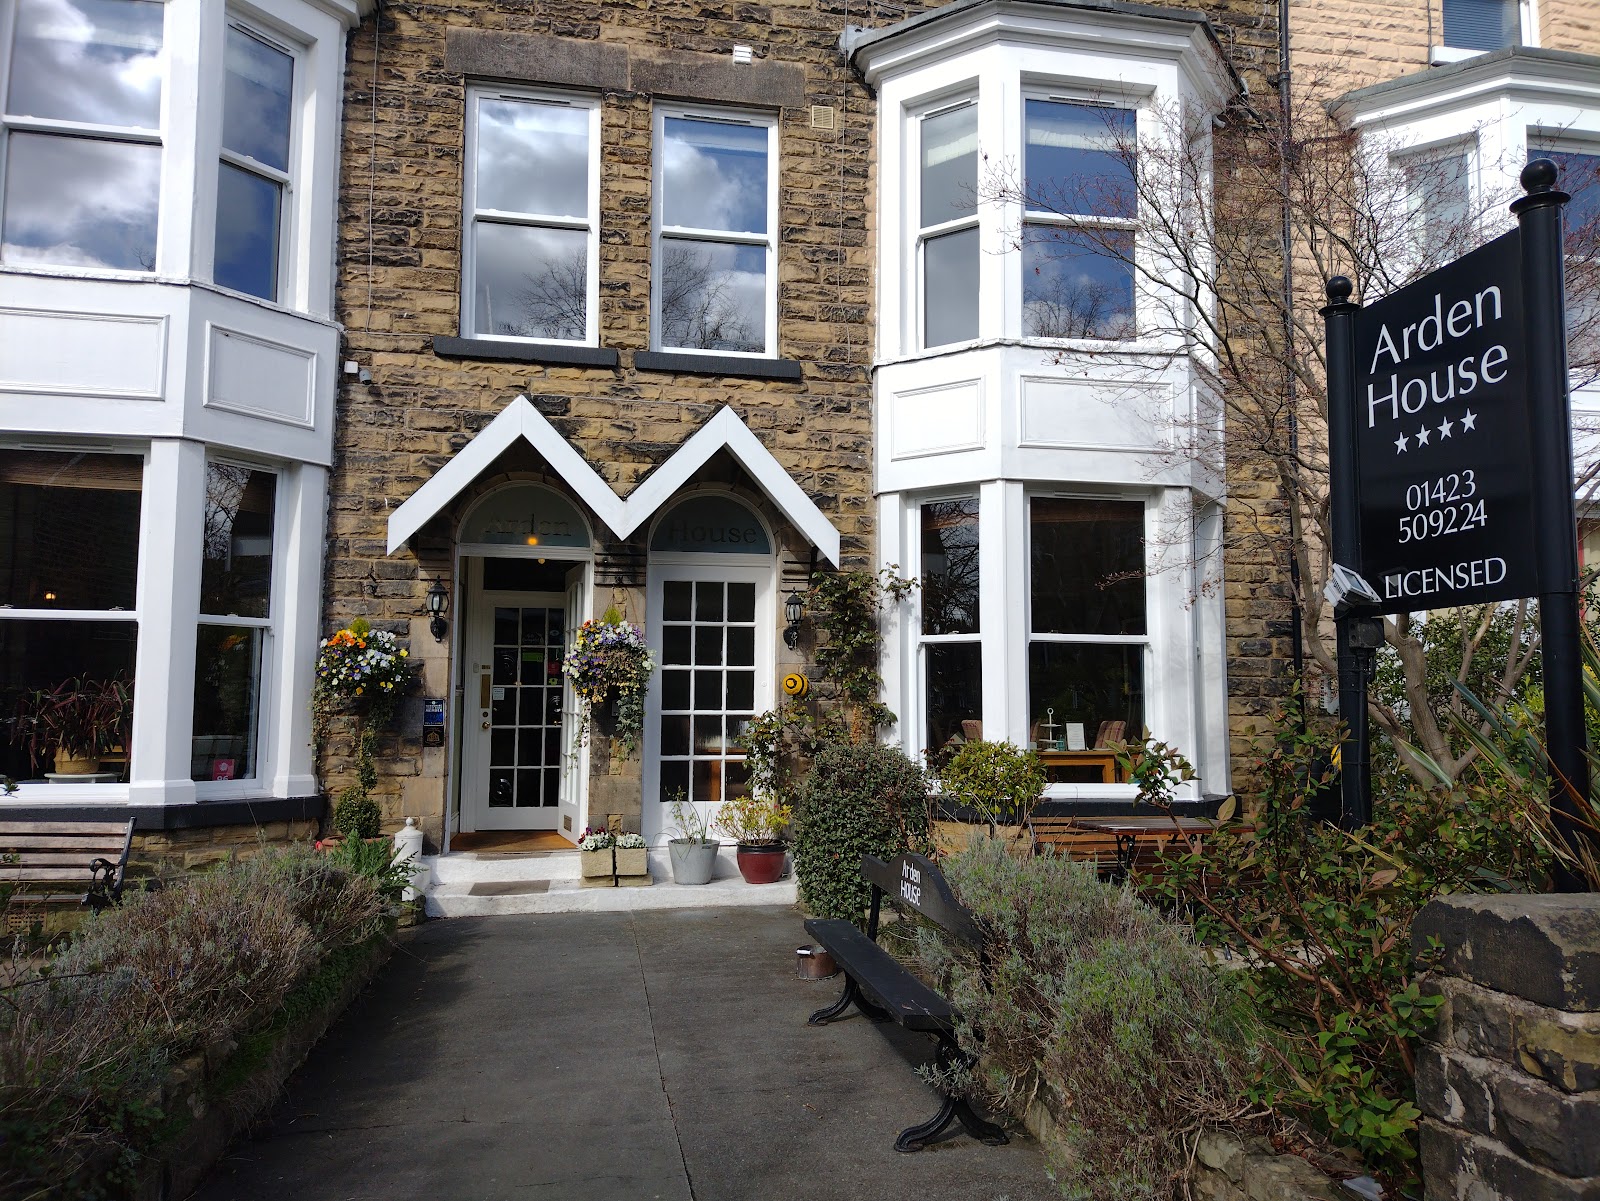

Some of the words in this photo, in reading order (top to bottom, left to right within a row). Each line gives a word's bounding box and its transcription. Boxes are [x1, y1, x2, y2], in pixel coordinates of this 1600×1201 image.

[1369, 285, 1502, 375] Arden
[1367, 344, 1508, 428] House
[1406, 469, 1476, 511] 01423
[484, 513, 572, 537] Arden
[668, 519, 757, 543] House
[1398, 498, 1488, 544] 509224
[1384, 557, 1507, 599] LICENSED
[902, 860, 921, 884] Arden
